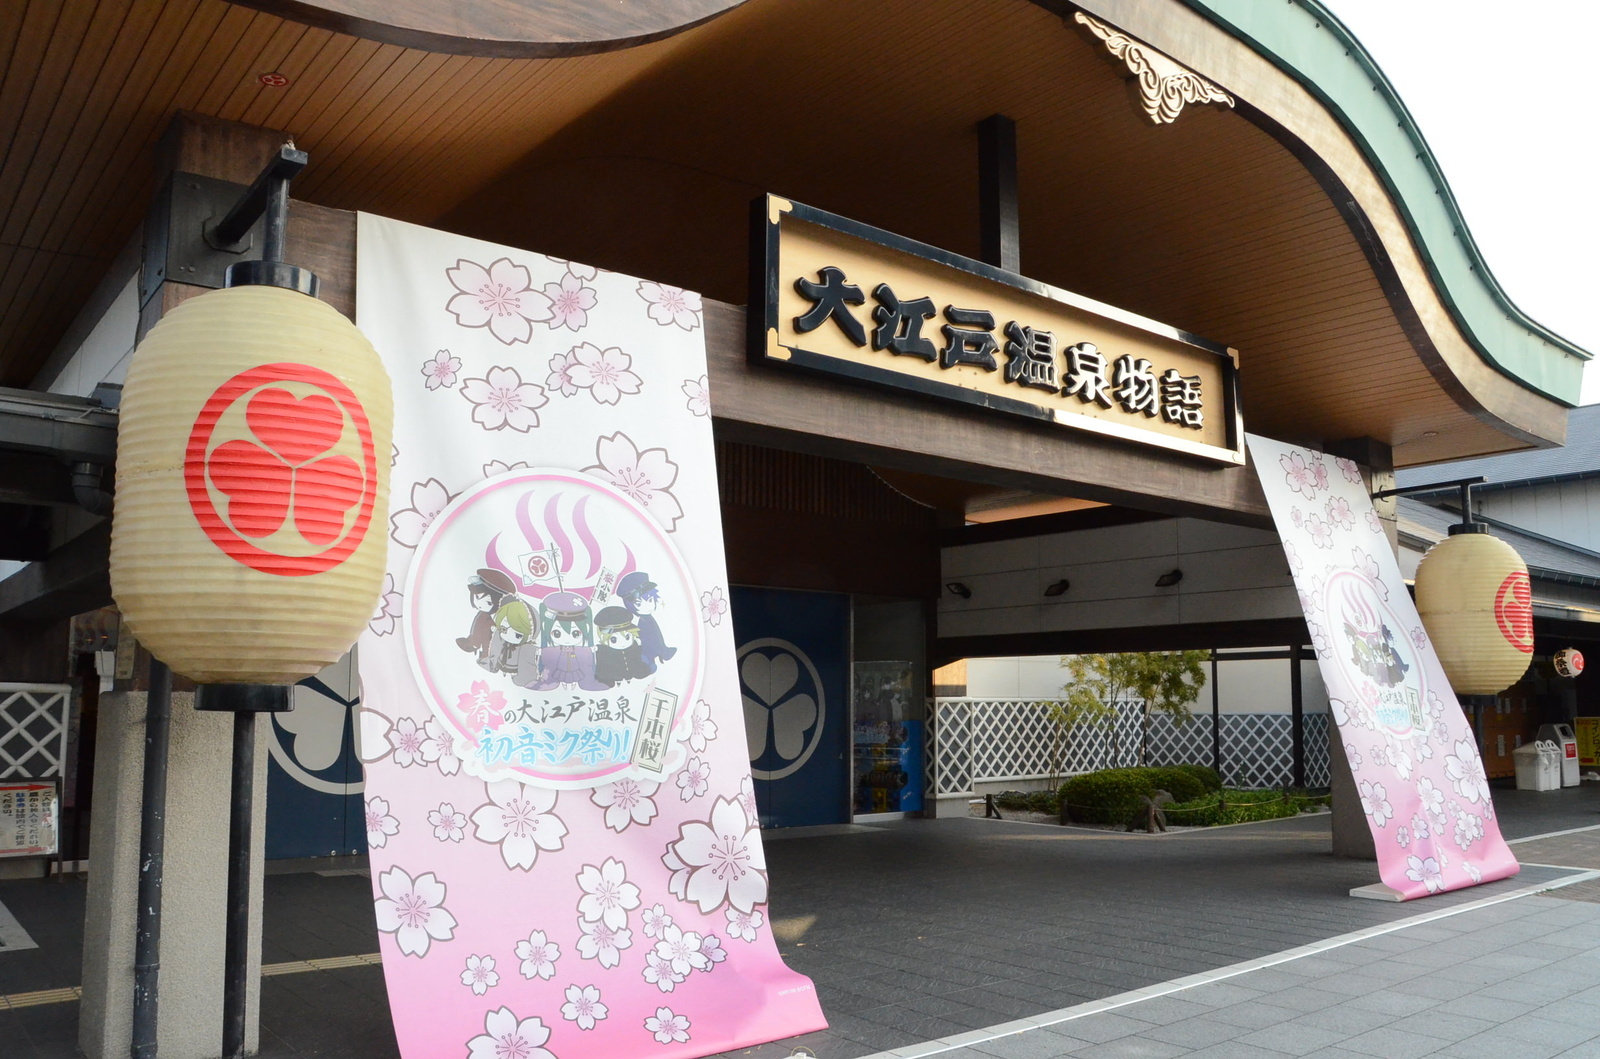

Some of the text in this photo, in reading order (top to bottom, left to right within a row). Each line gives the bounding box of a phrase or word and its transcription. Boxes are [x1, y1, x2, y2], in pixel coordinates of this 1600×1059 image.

[794, 266, 1203, 429] 大江戸温泉物語
[470, 689, 638, 724] 春の大江戸温泉
[638, 697, 670, 765] 千本桜
[476, 726, 630, 765] 初音ミク祭り!
